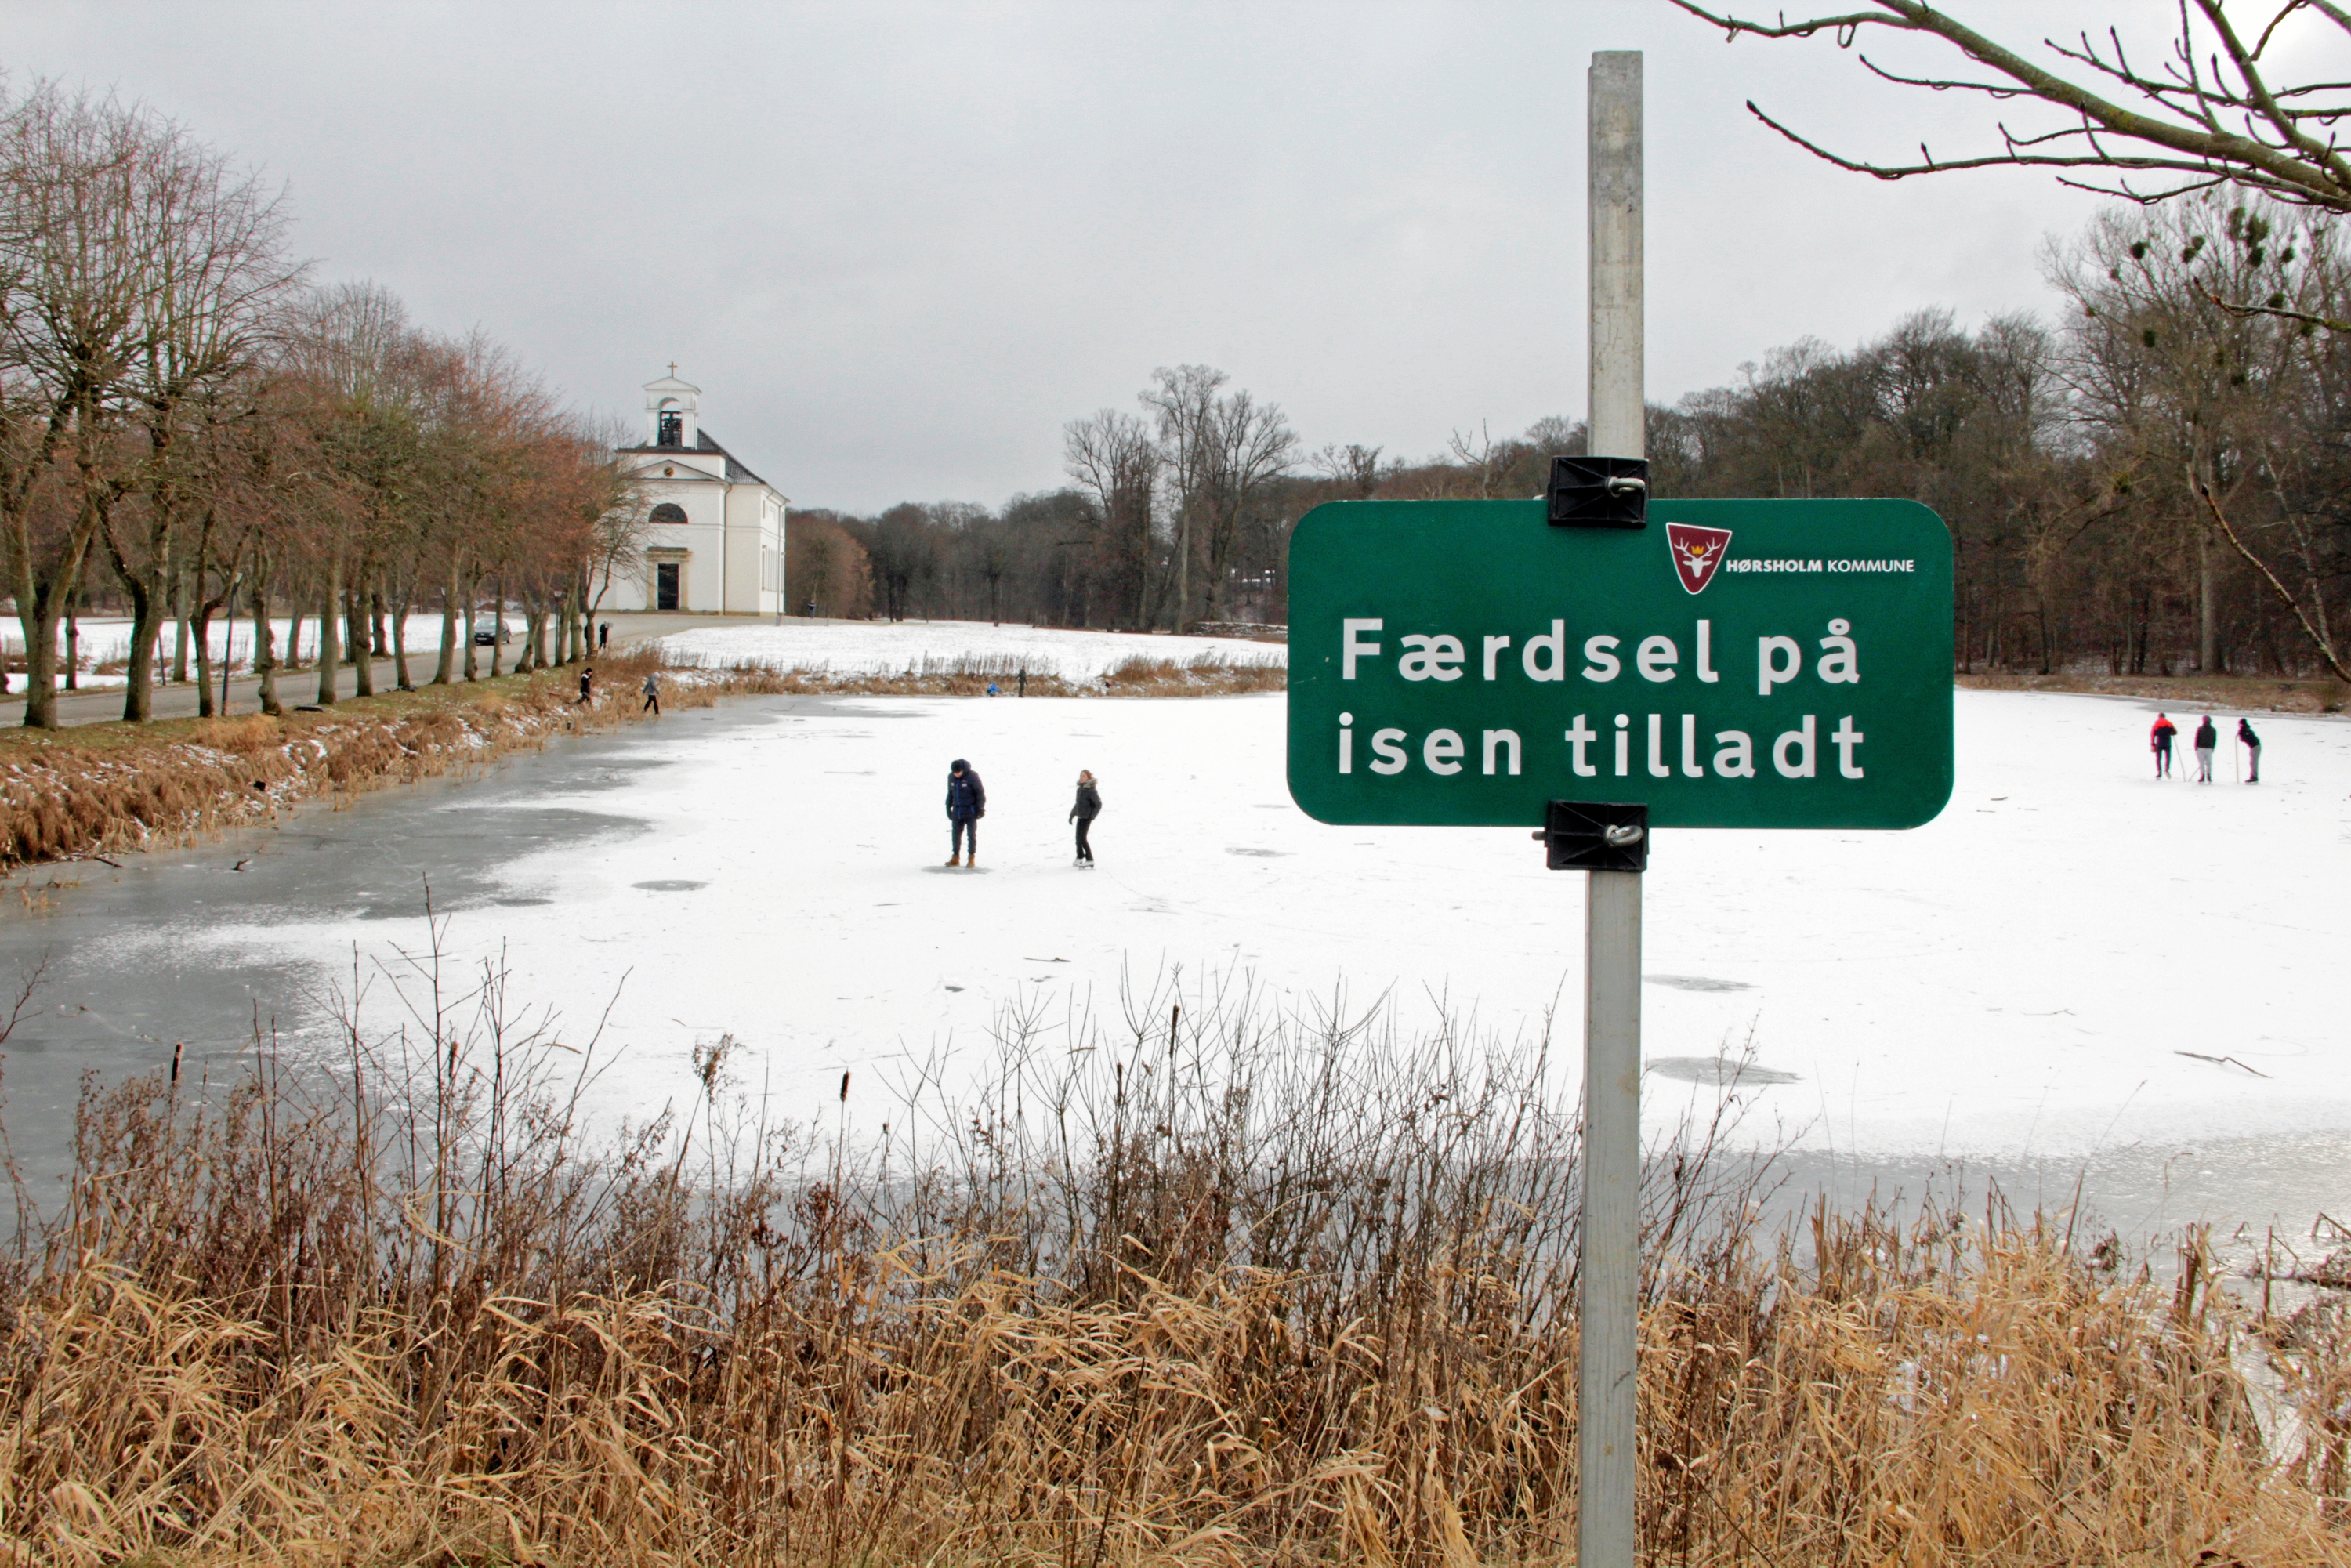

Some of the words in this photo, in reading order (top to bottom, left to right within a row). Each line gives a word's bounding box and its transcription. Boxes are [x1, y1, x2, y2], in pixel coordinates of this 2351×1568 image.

[1726, 559, 1823, 573] HØRSHOLM
[1828, 559, 1914, 572] KOMMUNE
[1342, 618, 1719, 683] Færdsel
[1759, 618, 1860, 696] på
[1338, 712, 1521, 776] isen
[1565, 713, 1864, 780] tilladt
